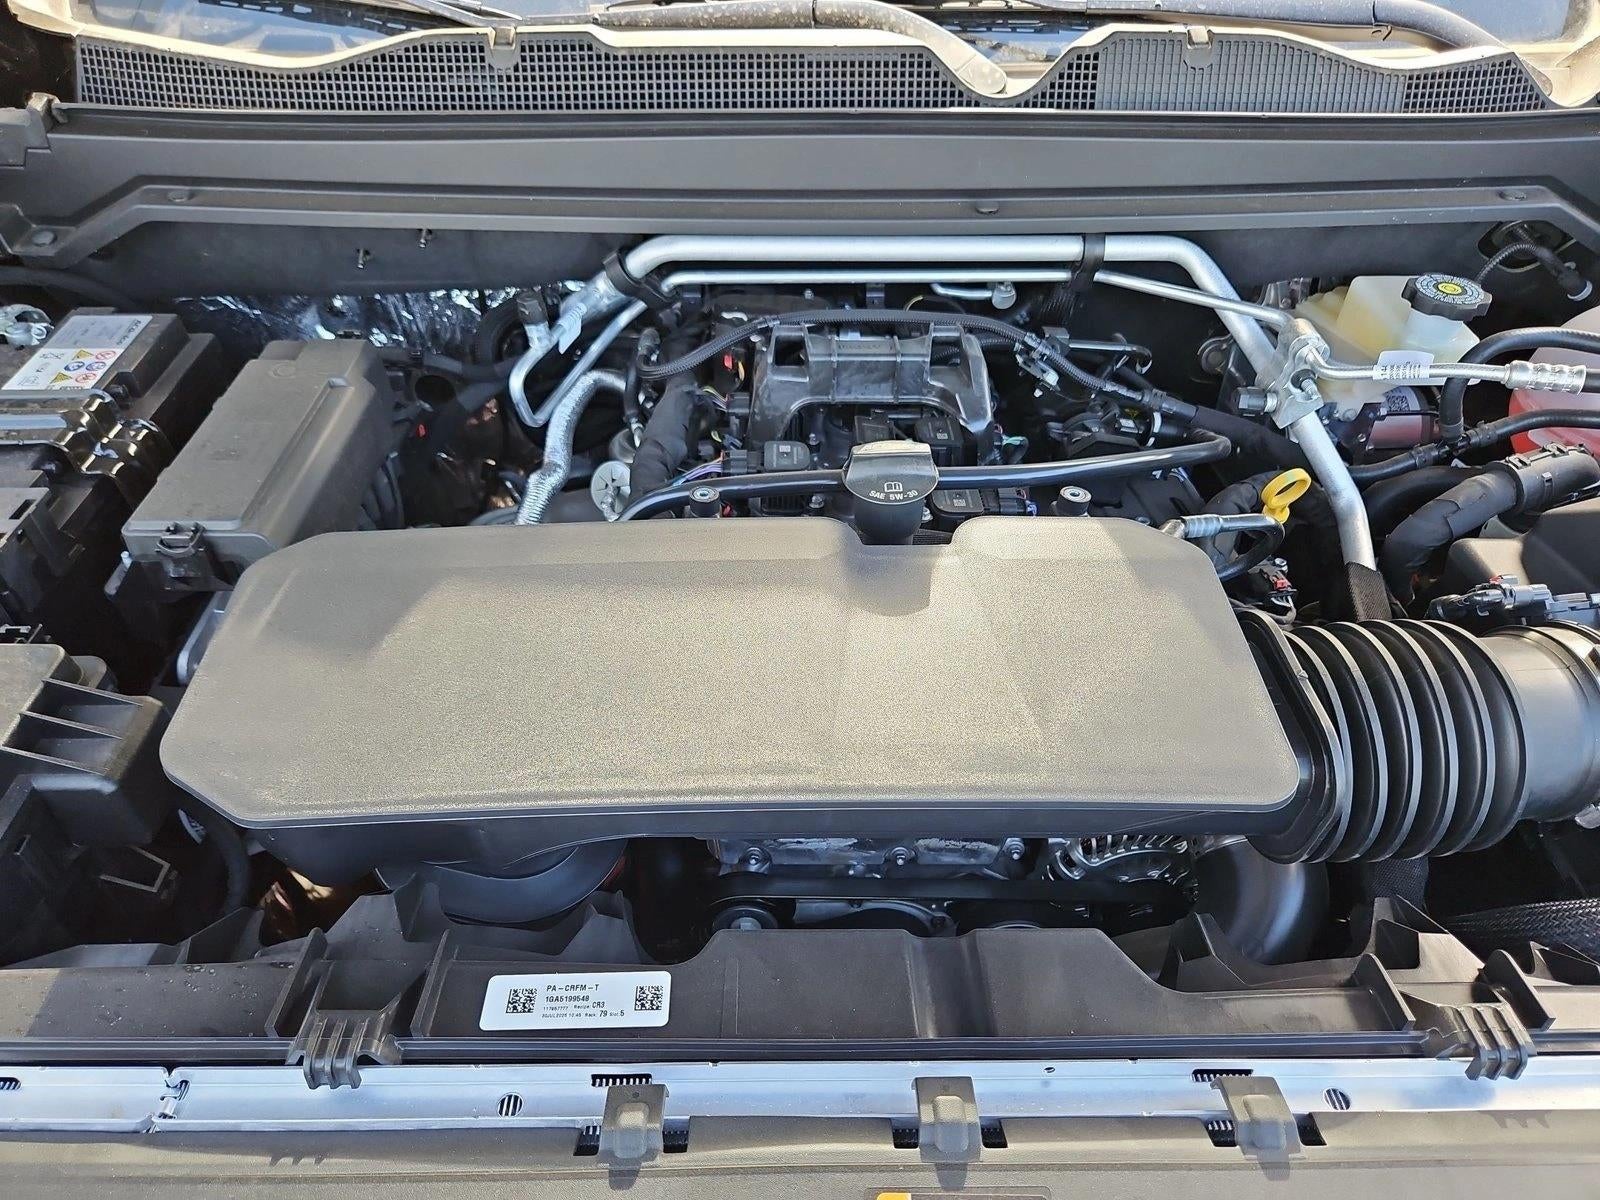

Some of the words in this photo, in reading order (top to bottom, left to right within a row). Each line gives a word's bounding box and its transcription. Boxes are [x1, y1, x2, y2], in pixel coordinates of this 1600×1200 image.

[869, 490, 886, 500] SAE
[889, 490, 919, 501] 5W-30
[592, 1001, 605, 1009] CR3
[599, 1010, 608, 1018] 79
